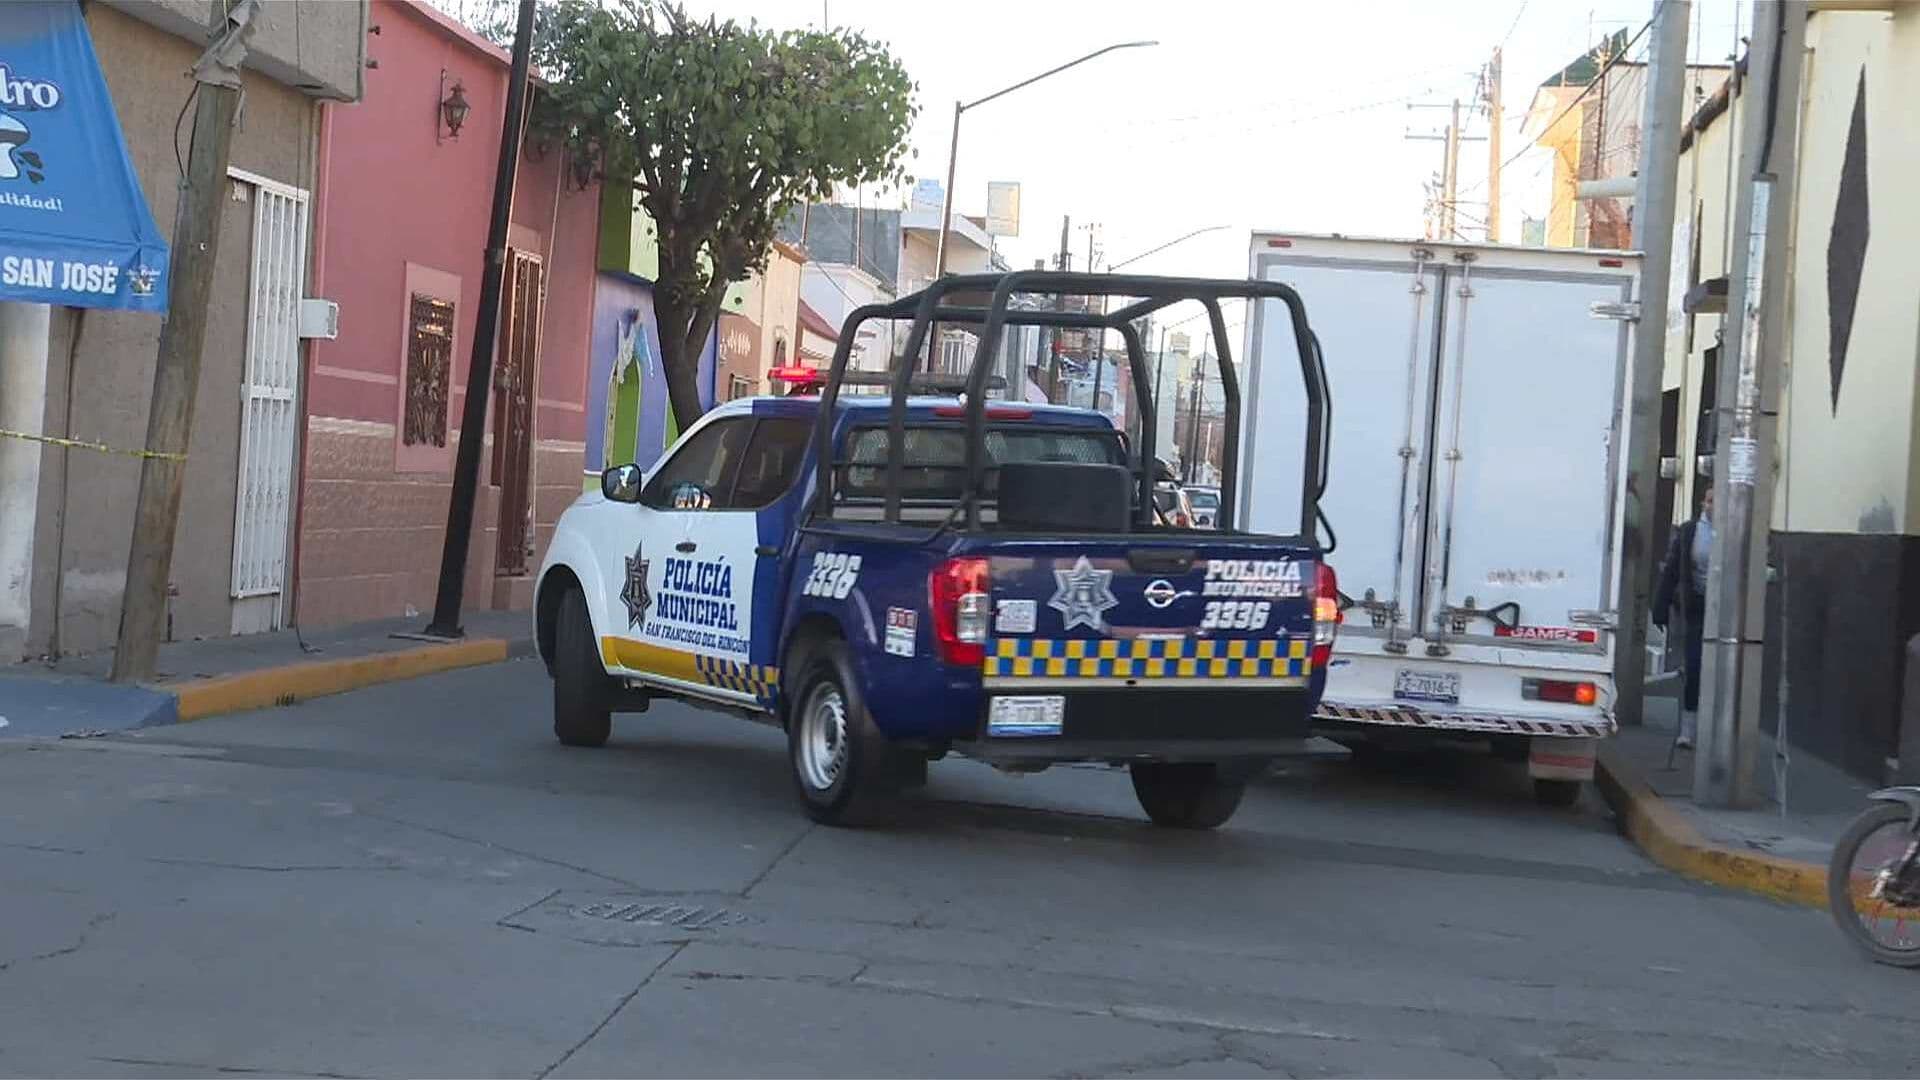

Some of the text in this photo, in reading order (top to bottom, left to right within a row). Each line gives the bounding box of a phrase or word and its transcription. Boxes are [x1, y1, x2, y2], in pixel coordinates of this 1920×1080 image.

[3, 256, 54, 288] SAN
[61, 260, 119, 294] JOSÉ
[663, 556, 732, 598] POLICÍA
[803, 551, 863, 599] 3336
[1204, 556, 1301, 581] POLICÍA
[1202, 581, 1303, 597] MUNICIPAL
[657, 593, 738, 631] MUNICIPAL
[1200, 601, 1272, 631] 3336
[645, 621, 661, 637] SAN
[661, 625, 701, 645] FRANCISCO
[702, 632, 716, 649] DEL
